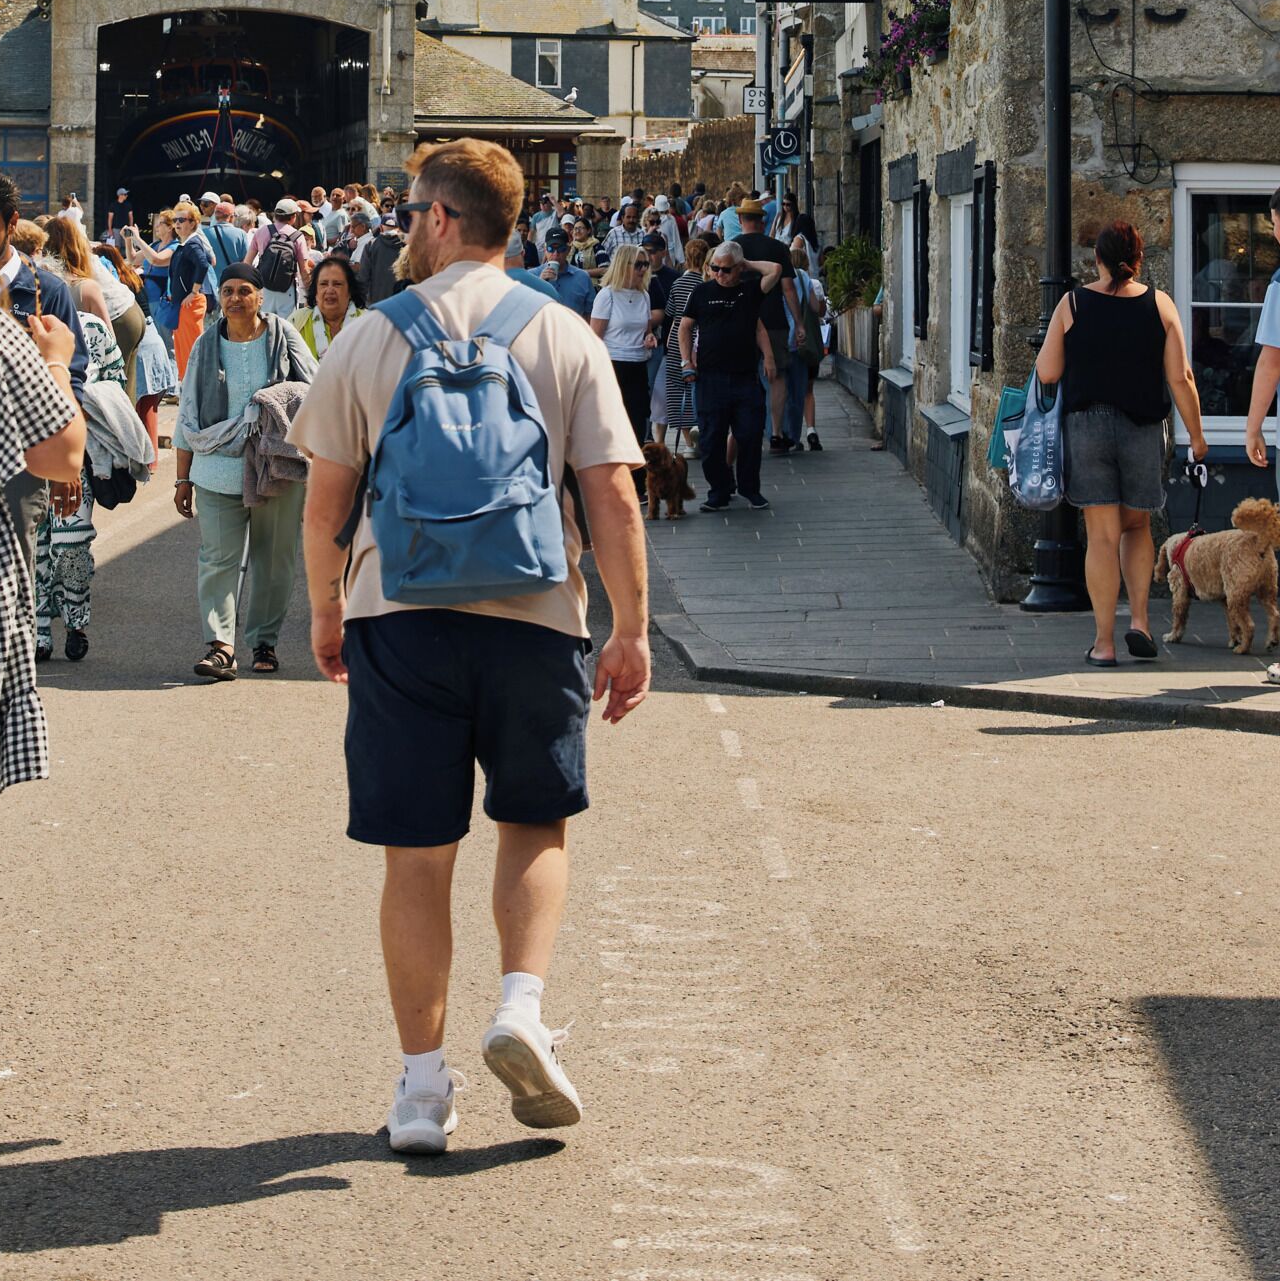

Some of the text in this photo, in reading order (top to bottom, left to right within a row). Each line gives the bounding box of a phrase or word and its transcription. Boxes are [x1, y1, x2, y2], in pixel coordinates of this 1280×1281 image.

[161, 128, 214, 161] RNLI 13-11
[231, 128, 257, 153] RNLI
[1032, 421, 1041, 470] RECYCLED
[1047, 423, 1055, 472] RECYCLED
